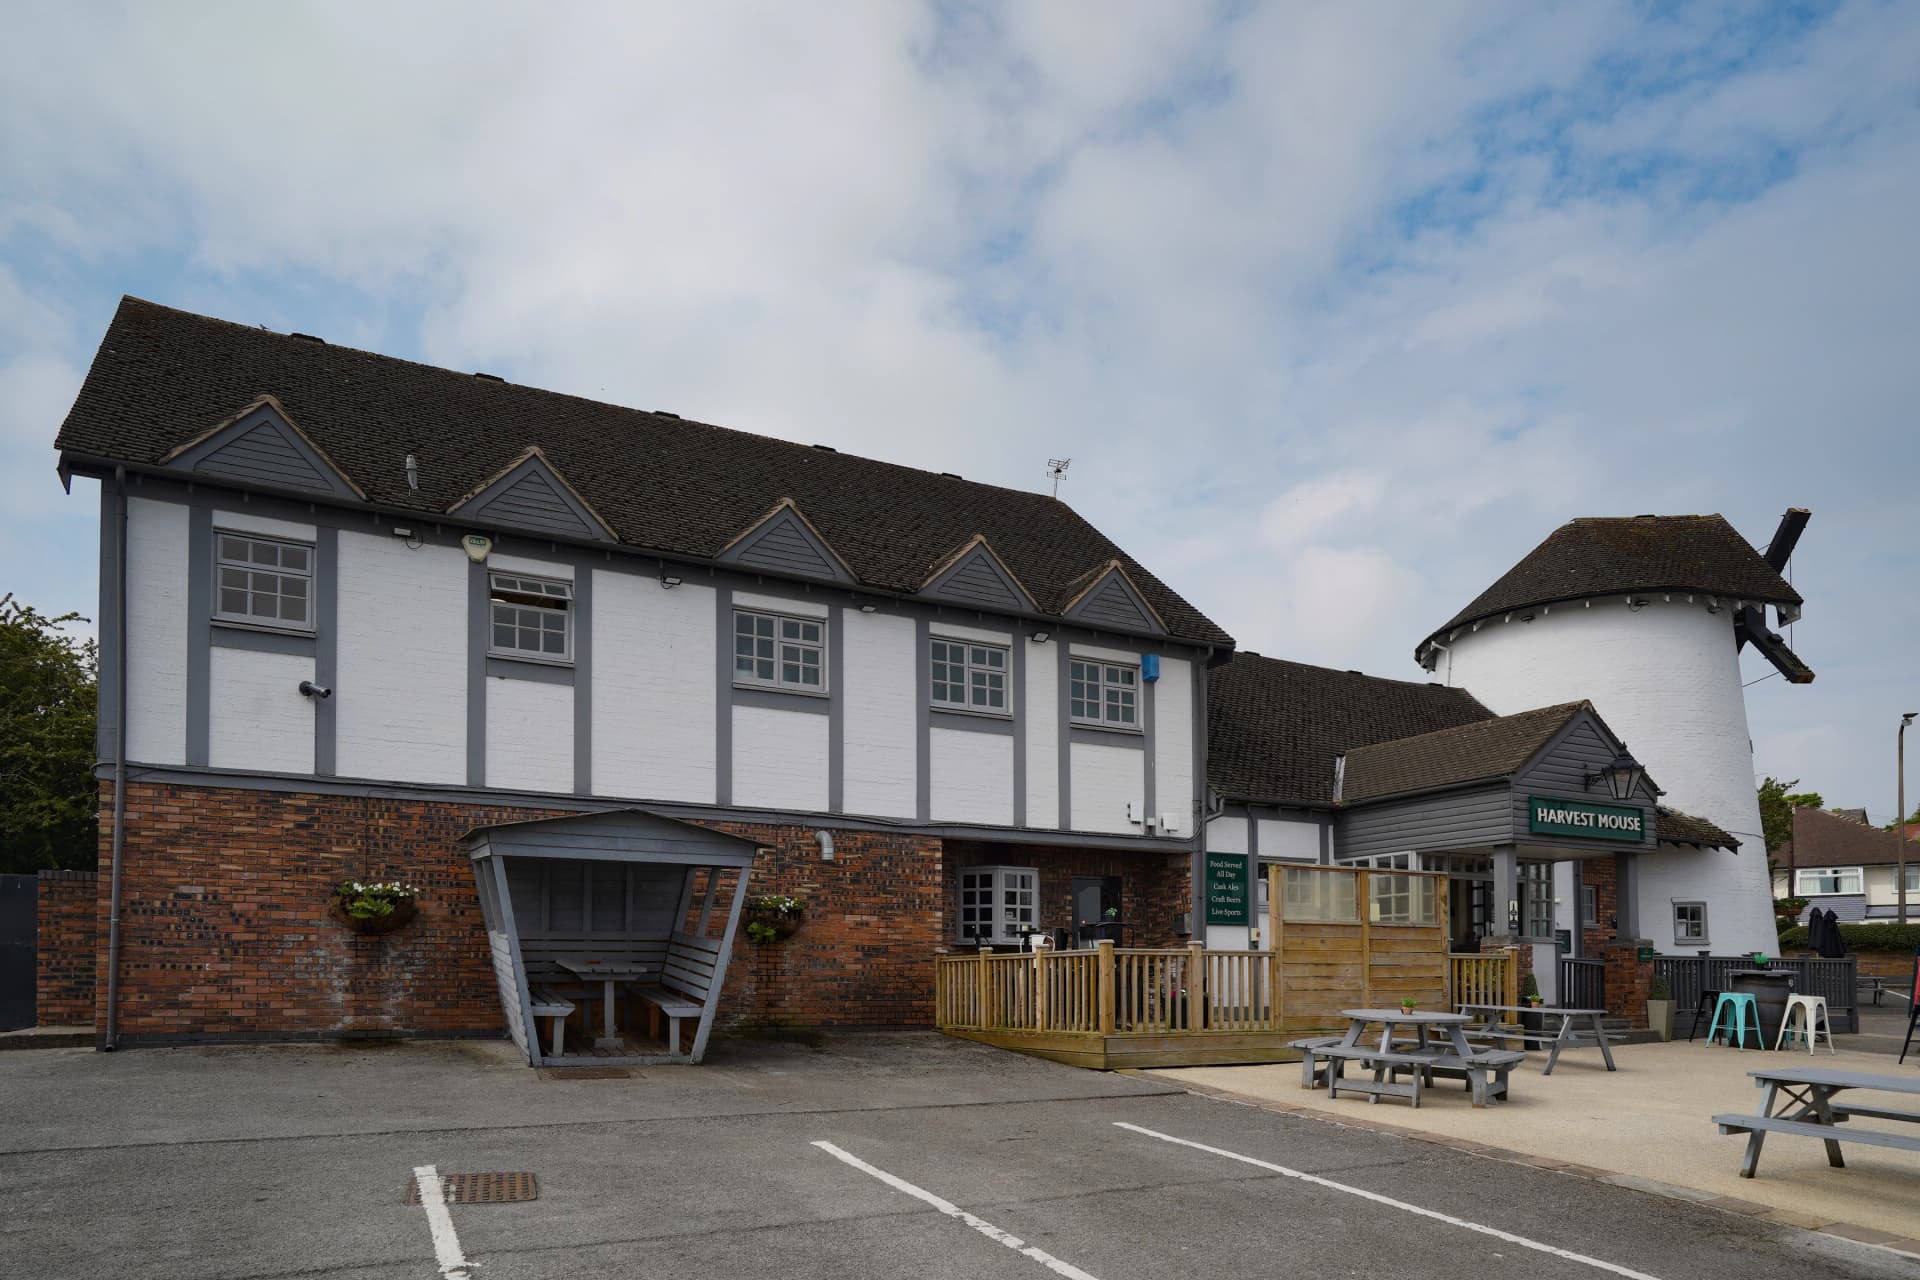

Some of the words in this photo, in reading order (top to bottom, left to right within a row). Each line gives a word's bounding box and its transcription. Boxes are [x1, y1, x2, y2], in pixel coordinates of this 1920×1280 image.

[1537, 808, 1596, 827] HARVEST
[1598, 814, 1642, 831] MOUSE
[1210, 860, 1223, 868] Food
[1224, 861, 1242, 869] Served
[1225, 871, 1236, 879] Day
[1228, 883, 1239, 891] Ales
[1211, 895, 1225, 903] Craft
[1224, 909, 1241, 917] Sports
